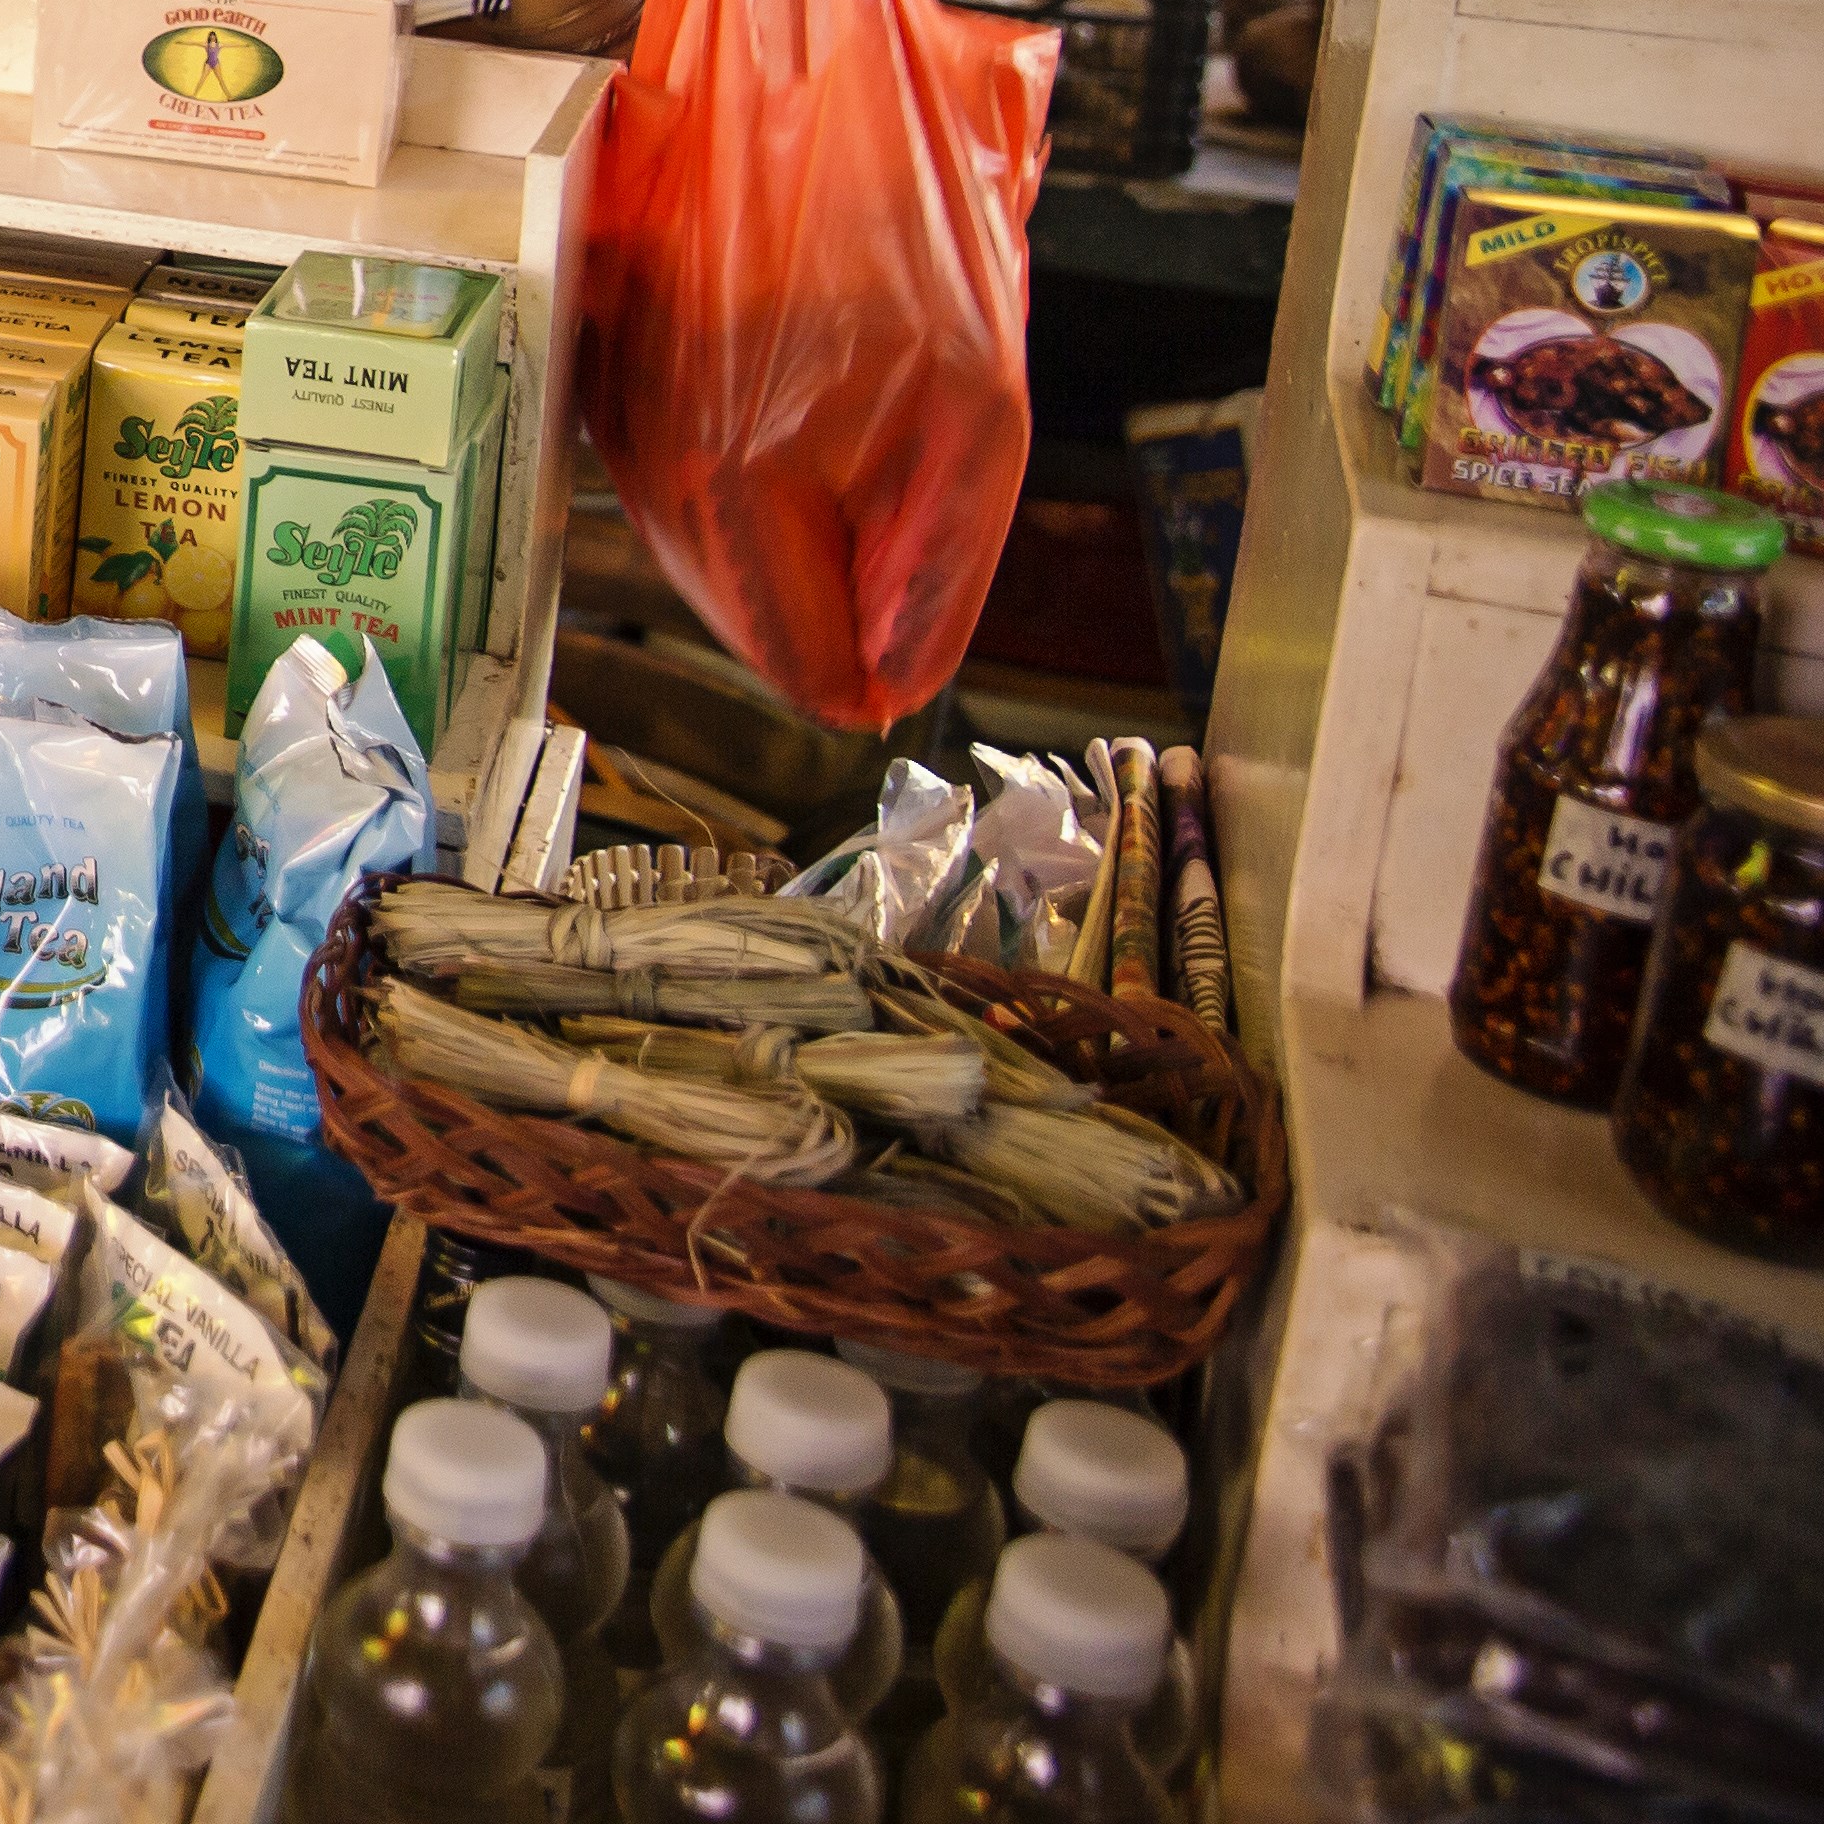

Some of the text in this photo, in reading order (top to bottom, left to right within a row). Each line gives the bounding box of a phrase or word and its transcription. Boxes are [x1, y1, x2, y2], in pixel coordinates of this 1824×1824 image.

[158, 92, 264, 121] GREEN TEA
[1479, 220, 1558, 257] MILD
[57, 294, 99, 310] TEA
[31, 320, 74, 335] TEA
[127, 332, 243, 354] LEMO
[4, 349, 48, 366] TEA
[156, 348, 231, 369] TEA
[283, 355, 410, 394] MINT TEA
[291, 388, 396, 415] FINEST QUALITY
[103, 470, 239, 501] FINEST QUALITY
[1452, 457, 1531, 490] SPICE
[113, 487, 227, 522] LEMON
[139, 520, 199, 548] TEA
[282, 588, 392, 614] FINEST QUALITY
[273, 606, 400, 644] MINT TEA
[4, 813, 55, 829] QUALITY
[62, 815, 86, 833] TEA
[0, 909, 89, 970] Tea
[185, 1297, 261, 1382] VANILLA
